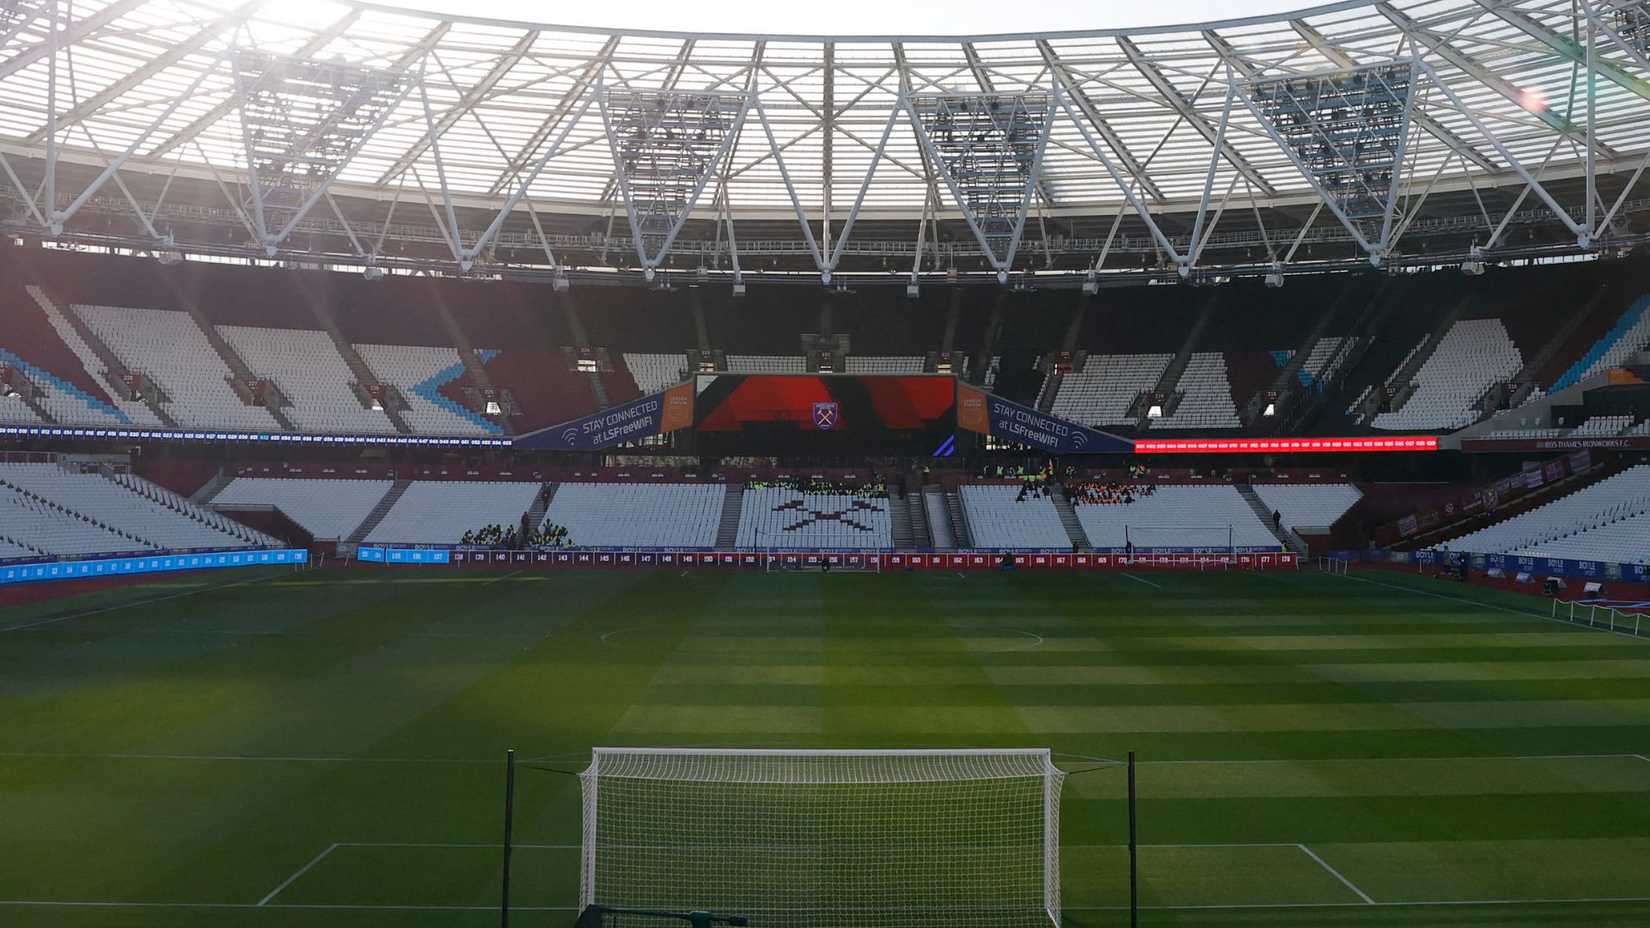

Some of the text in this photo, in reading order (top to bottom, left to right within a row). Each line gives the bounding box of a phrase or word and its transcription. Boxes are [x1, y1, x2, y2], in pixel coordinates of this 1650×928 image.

[583, 400, 657, 433] STAY CONNECTED
[993, 403, 1069, 437] STAY CONNECTED
[999, 419, 1008, 429] at
[593, 435, 602, 445] at
